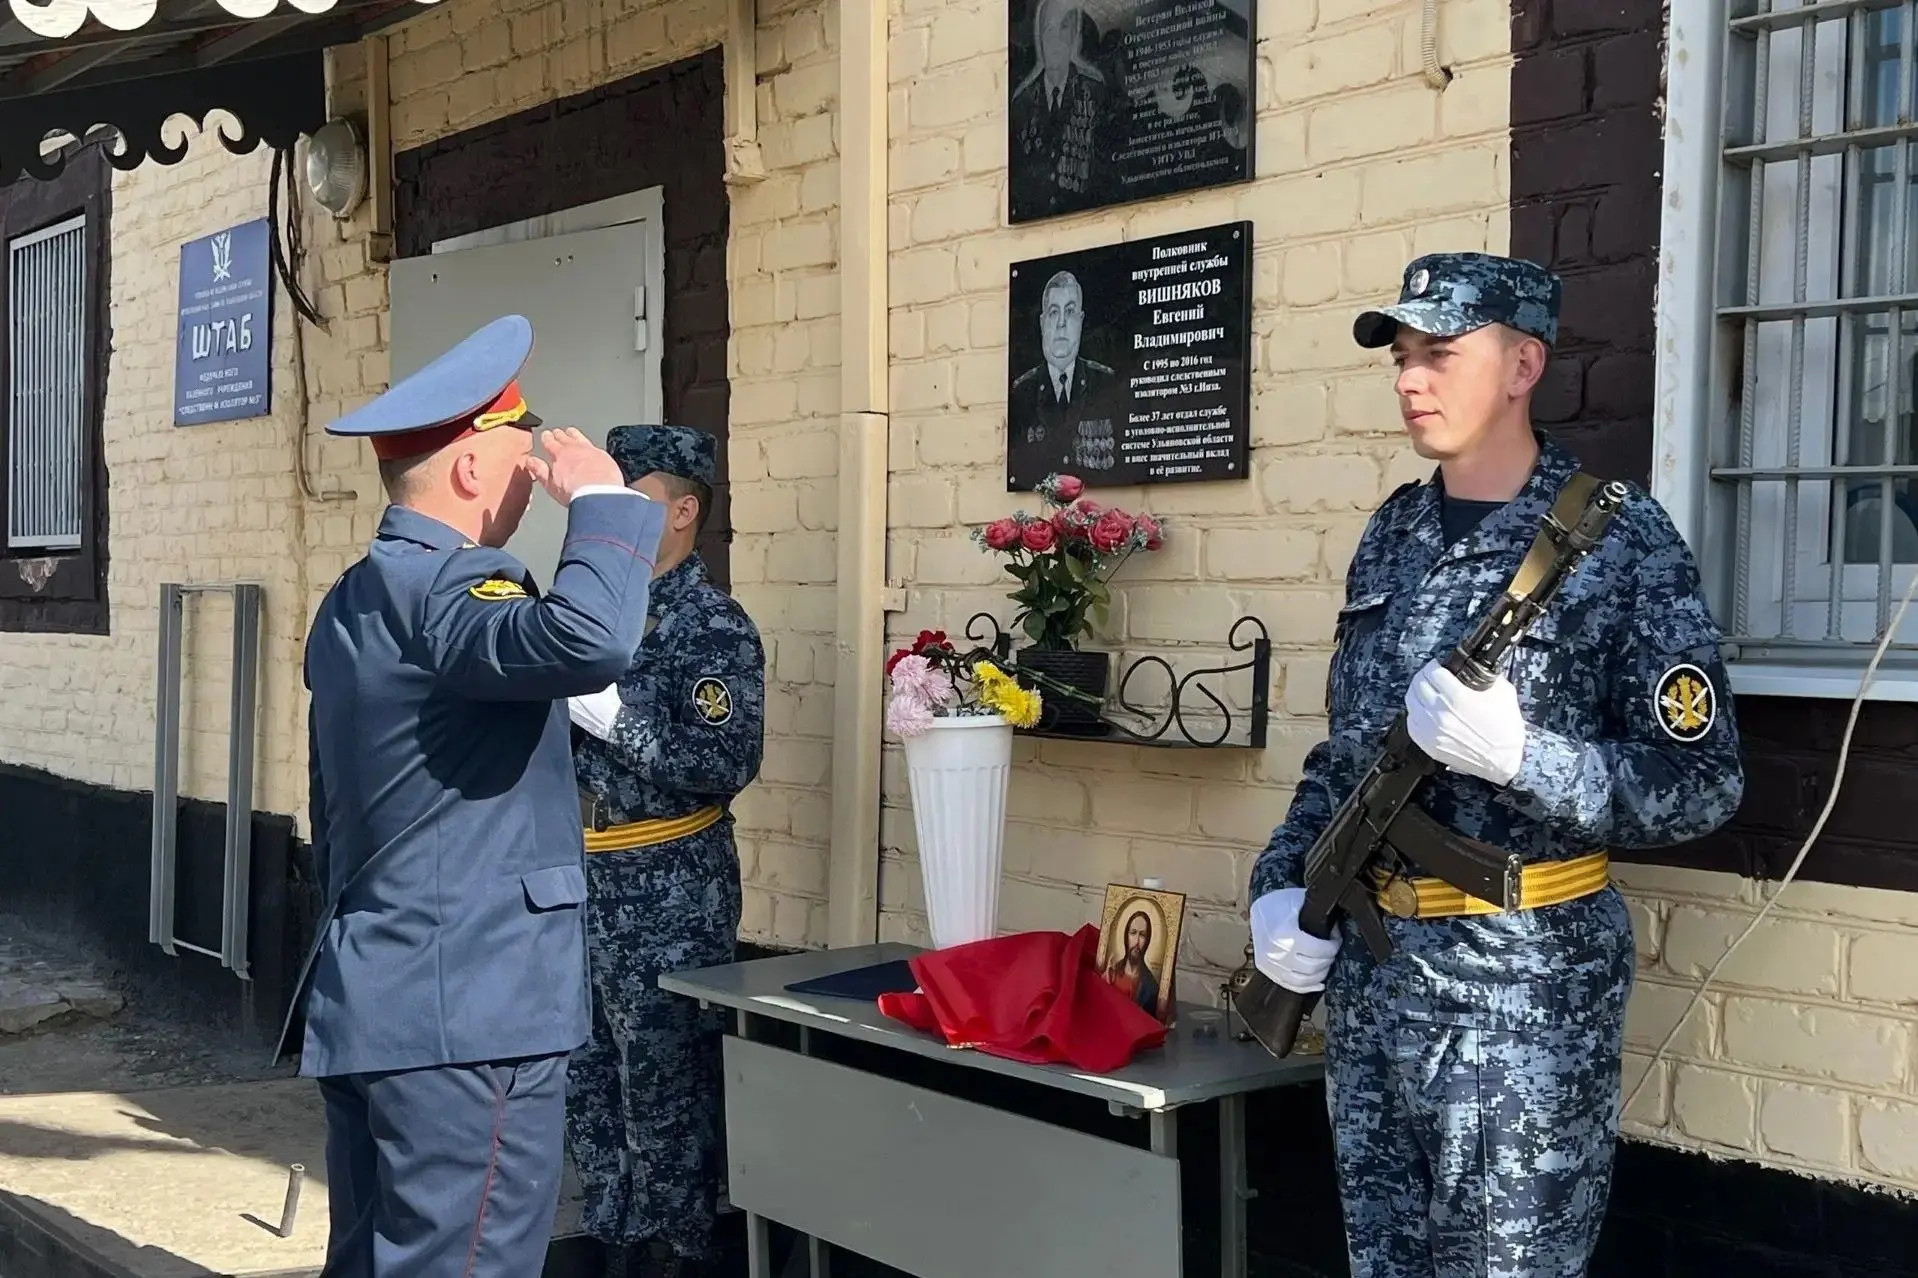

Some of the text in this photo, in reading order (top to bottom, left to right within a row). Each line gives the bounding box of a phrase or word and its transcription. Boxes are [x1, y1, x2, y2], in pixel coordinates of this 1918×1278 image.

[1124, 9, 1227, 45] Отечественной войны
[1152, 241, 1208, 261] Полковник
[1131, 254, 1229, 282] внутренней службы
[1138, 278, 1222, 306] ВИШНЯКОВ
[1153, 303, 1205, 325] Евгений
[192, 312, 254, 361] ШТАБ
[1133, 326, 1225, 350] Владимирович
[1152, 358, 1169, 370] 1995
[1169, 360, 1180, 368] по
[1180, 355, 1199, 367] 2016
[1130, 368, 1227, 388] руководил следственным
[1128, 404, 1228, 424] Более 37 лет отдал службе
[1131, 419, 1231, 439] уголовно-исполнительной
[1121, 433, 1234, 451] системе Ульяновской области
[1131, 455, 1149, 463] внес
[1150, 448, 1205, 462] значительный
[1205, 448, 1230, 458] вклад
